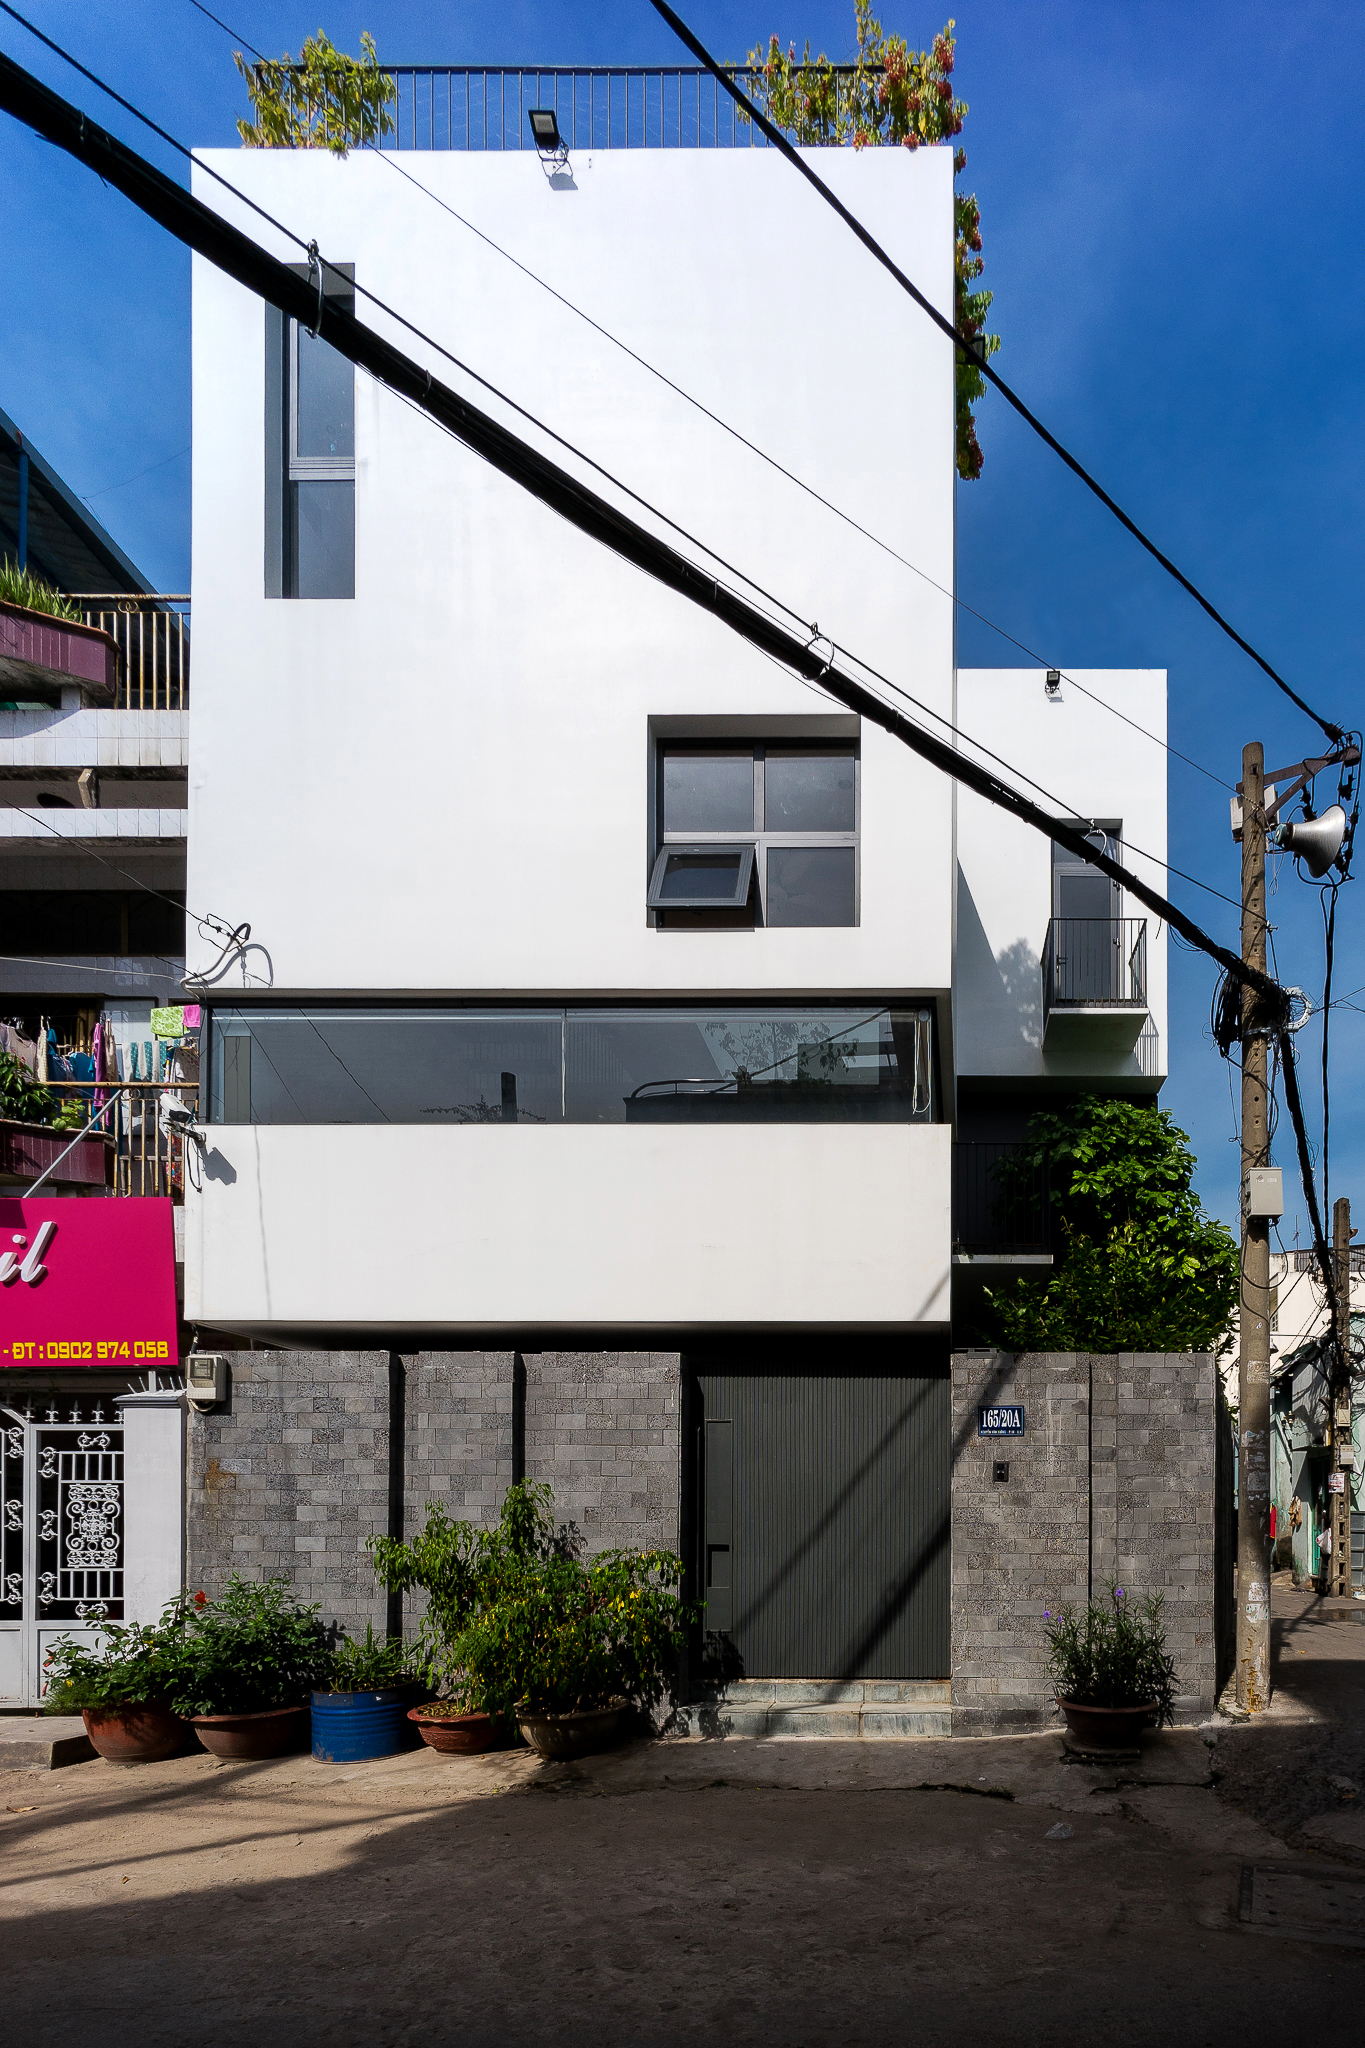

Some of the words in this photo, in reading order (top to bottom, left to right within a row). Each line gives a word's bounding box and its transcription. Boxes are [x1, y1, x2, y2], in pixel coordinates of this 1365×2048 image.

[96, 1341, 131, 1358] 974
[133, 1341, 169, 1358] 058
[982, 1409, 1021, 1428] 165/20A
